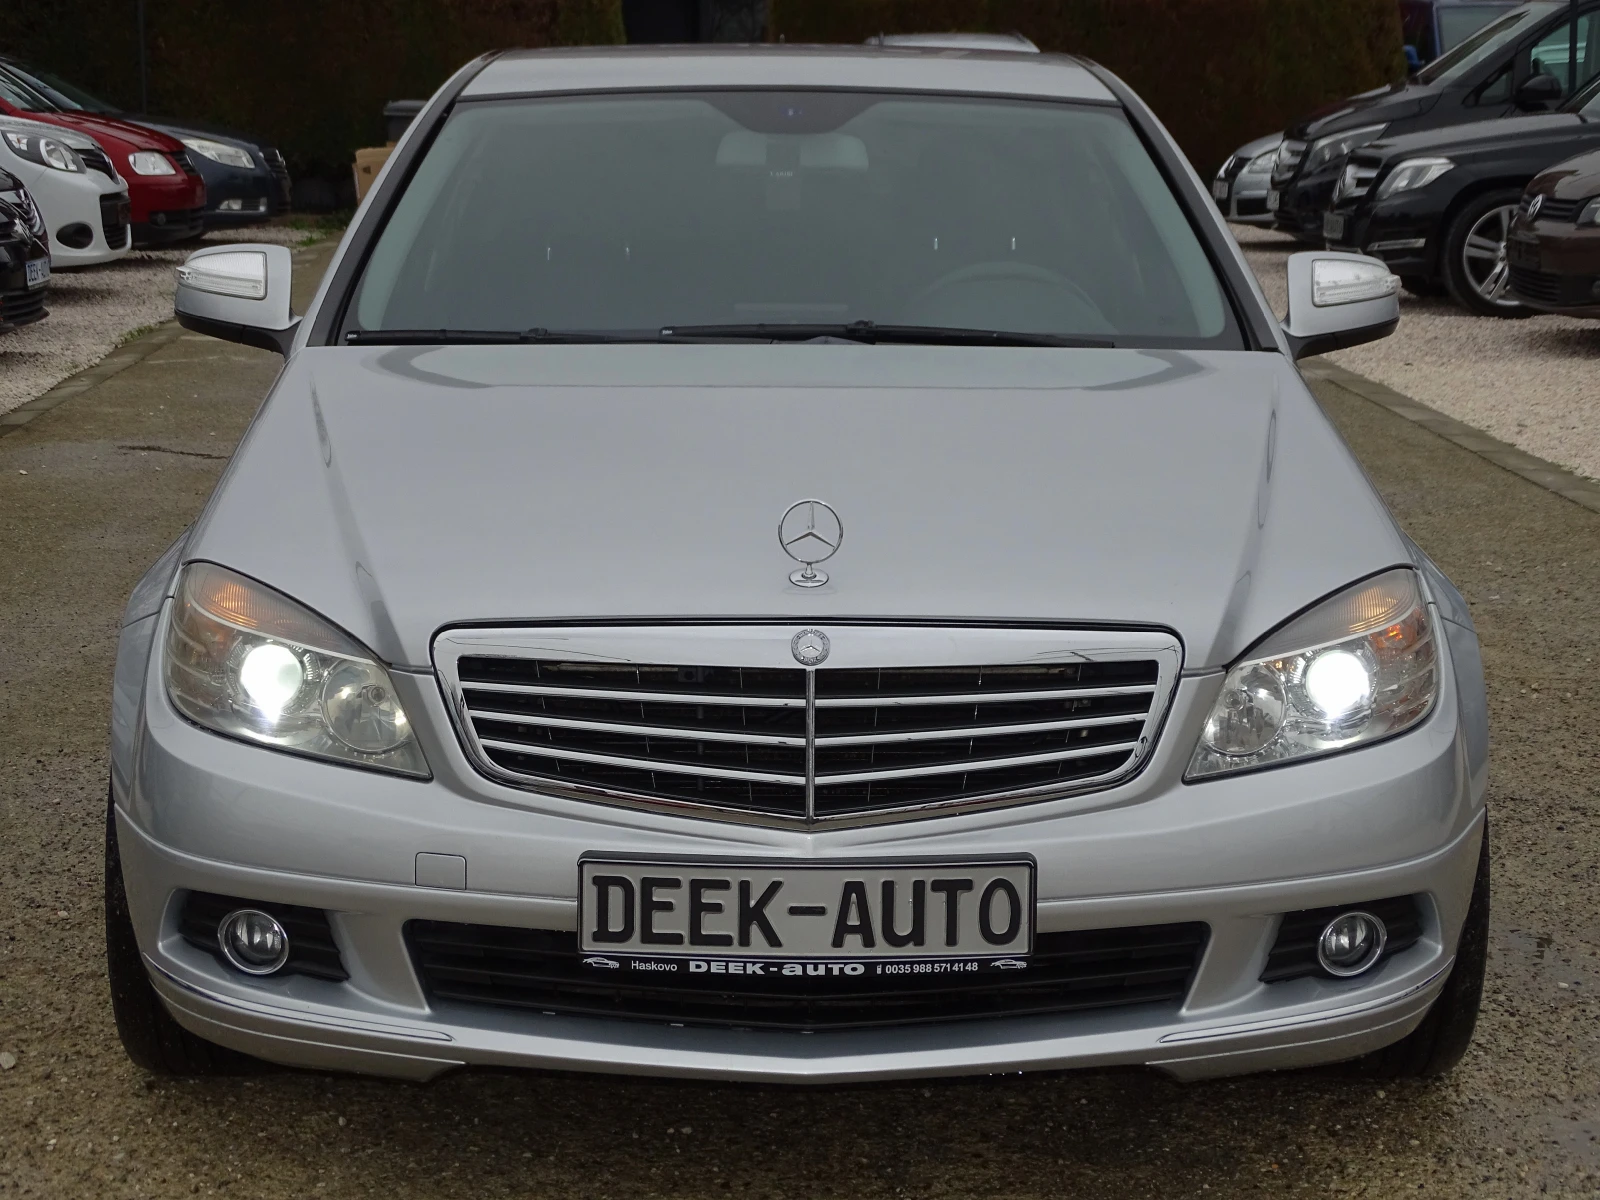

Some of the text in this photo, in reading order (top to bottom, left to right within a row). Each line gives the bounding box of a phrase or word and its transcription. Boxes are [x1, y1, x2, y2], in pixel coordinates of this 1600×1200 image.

[592, 875, 1022, 948] DEEK-AUTO
[631, 960, 678, 971] Haskovo
[885, 964, 911, 974] 0035
[913, 963, 932, 973] 988
